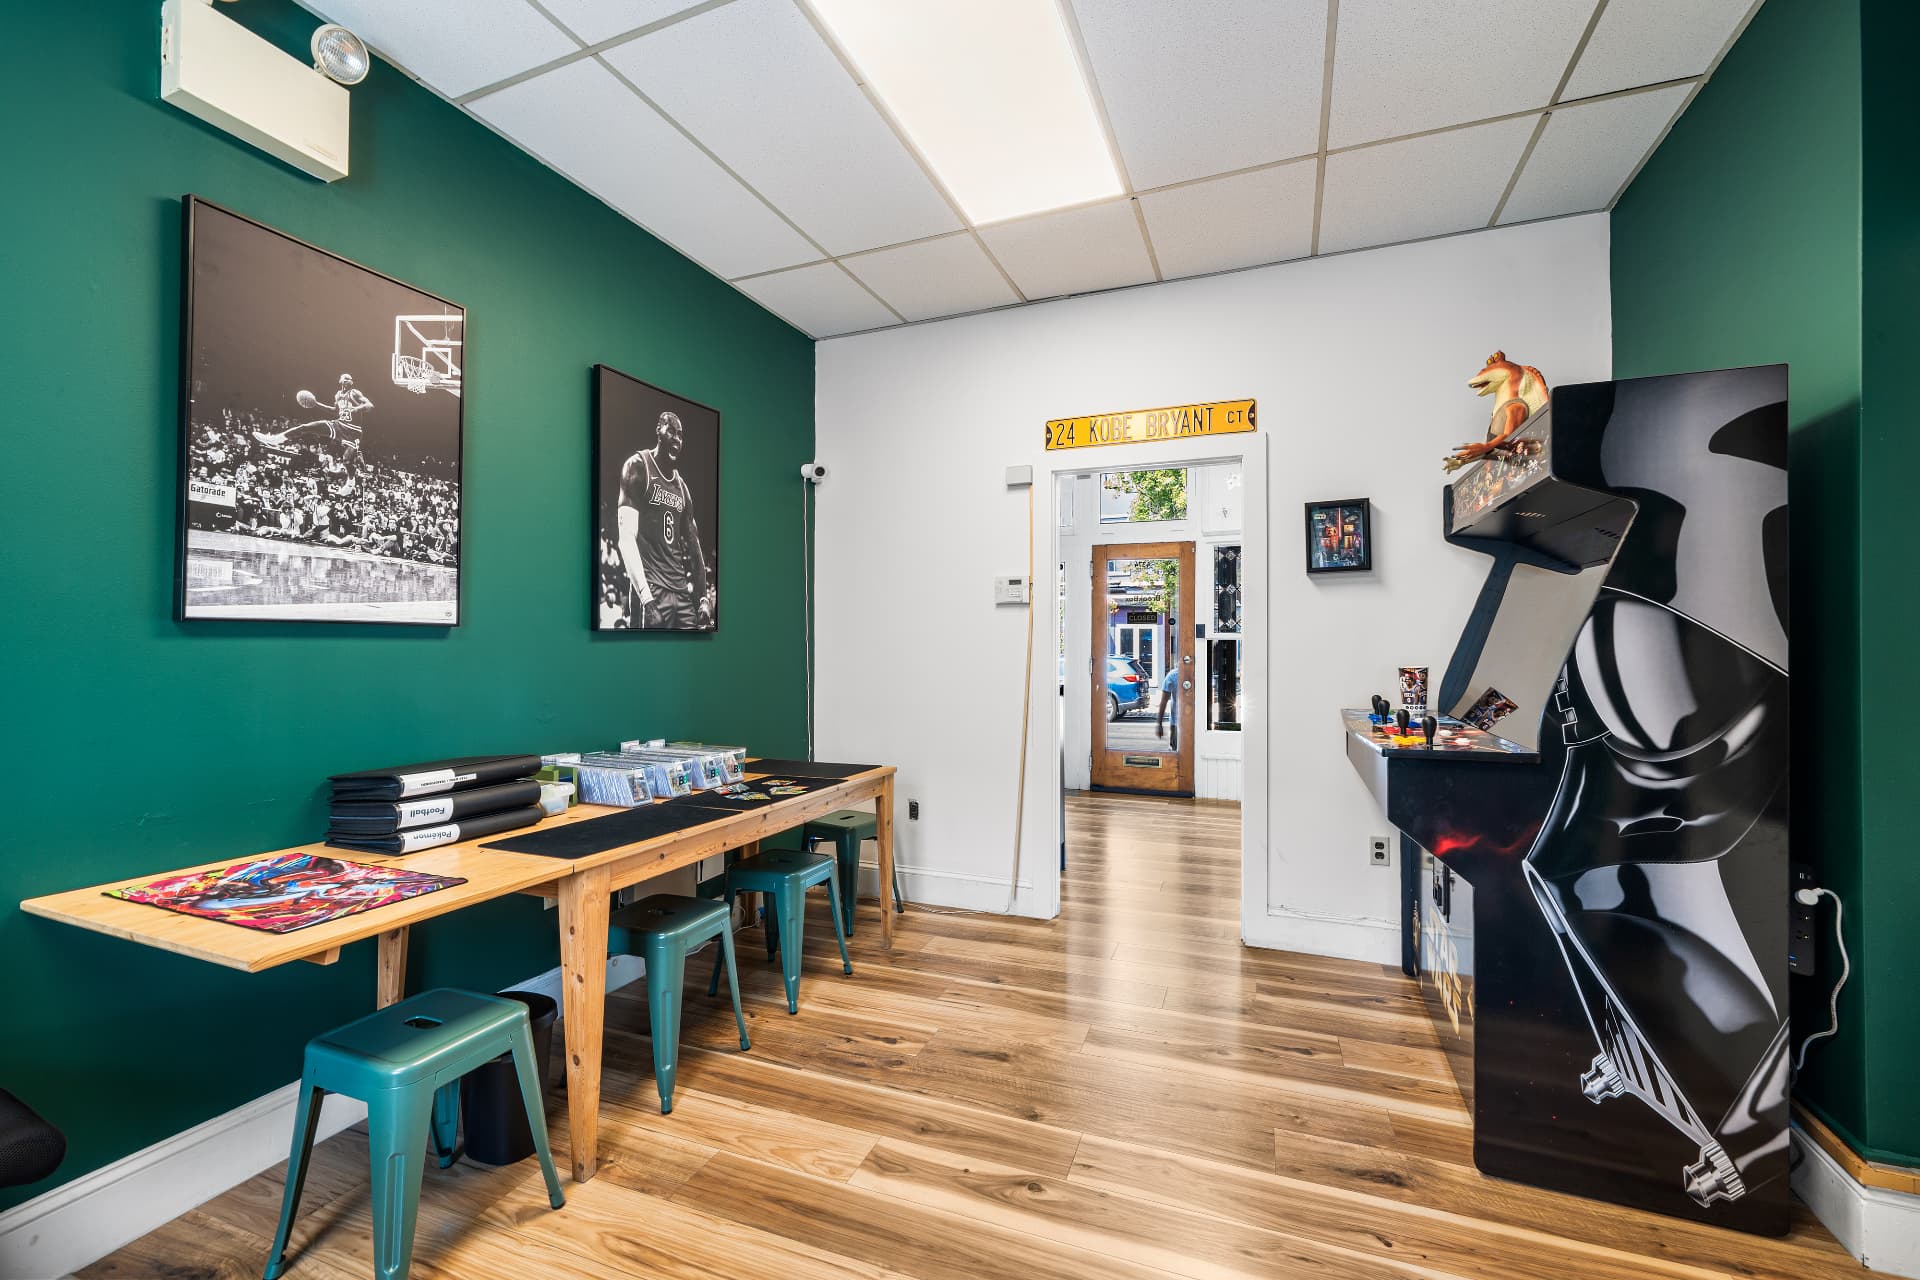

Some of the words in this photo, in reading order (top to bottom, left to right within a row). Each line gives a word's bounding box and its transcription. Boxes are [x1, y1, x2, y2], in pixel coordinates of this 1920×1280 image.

[1055, 422, 1075, 446] 24
[1089, 415, 1133, 443] KOBE
[1145, 407, 1214, 438] BRYANT
[1226, 410, 1244, 424] CT
[190, 483, 226, 497] Gatorade
[663, 510, 674, 545] 6
[1128, 613, 1156, 622] CLOSED
[410, 807, 445, 818] Football
[413, 830, 452, 840] Pokémon
